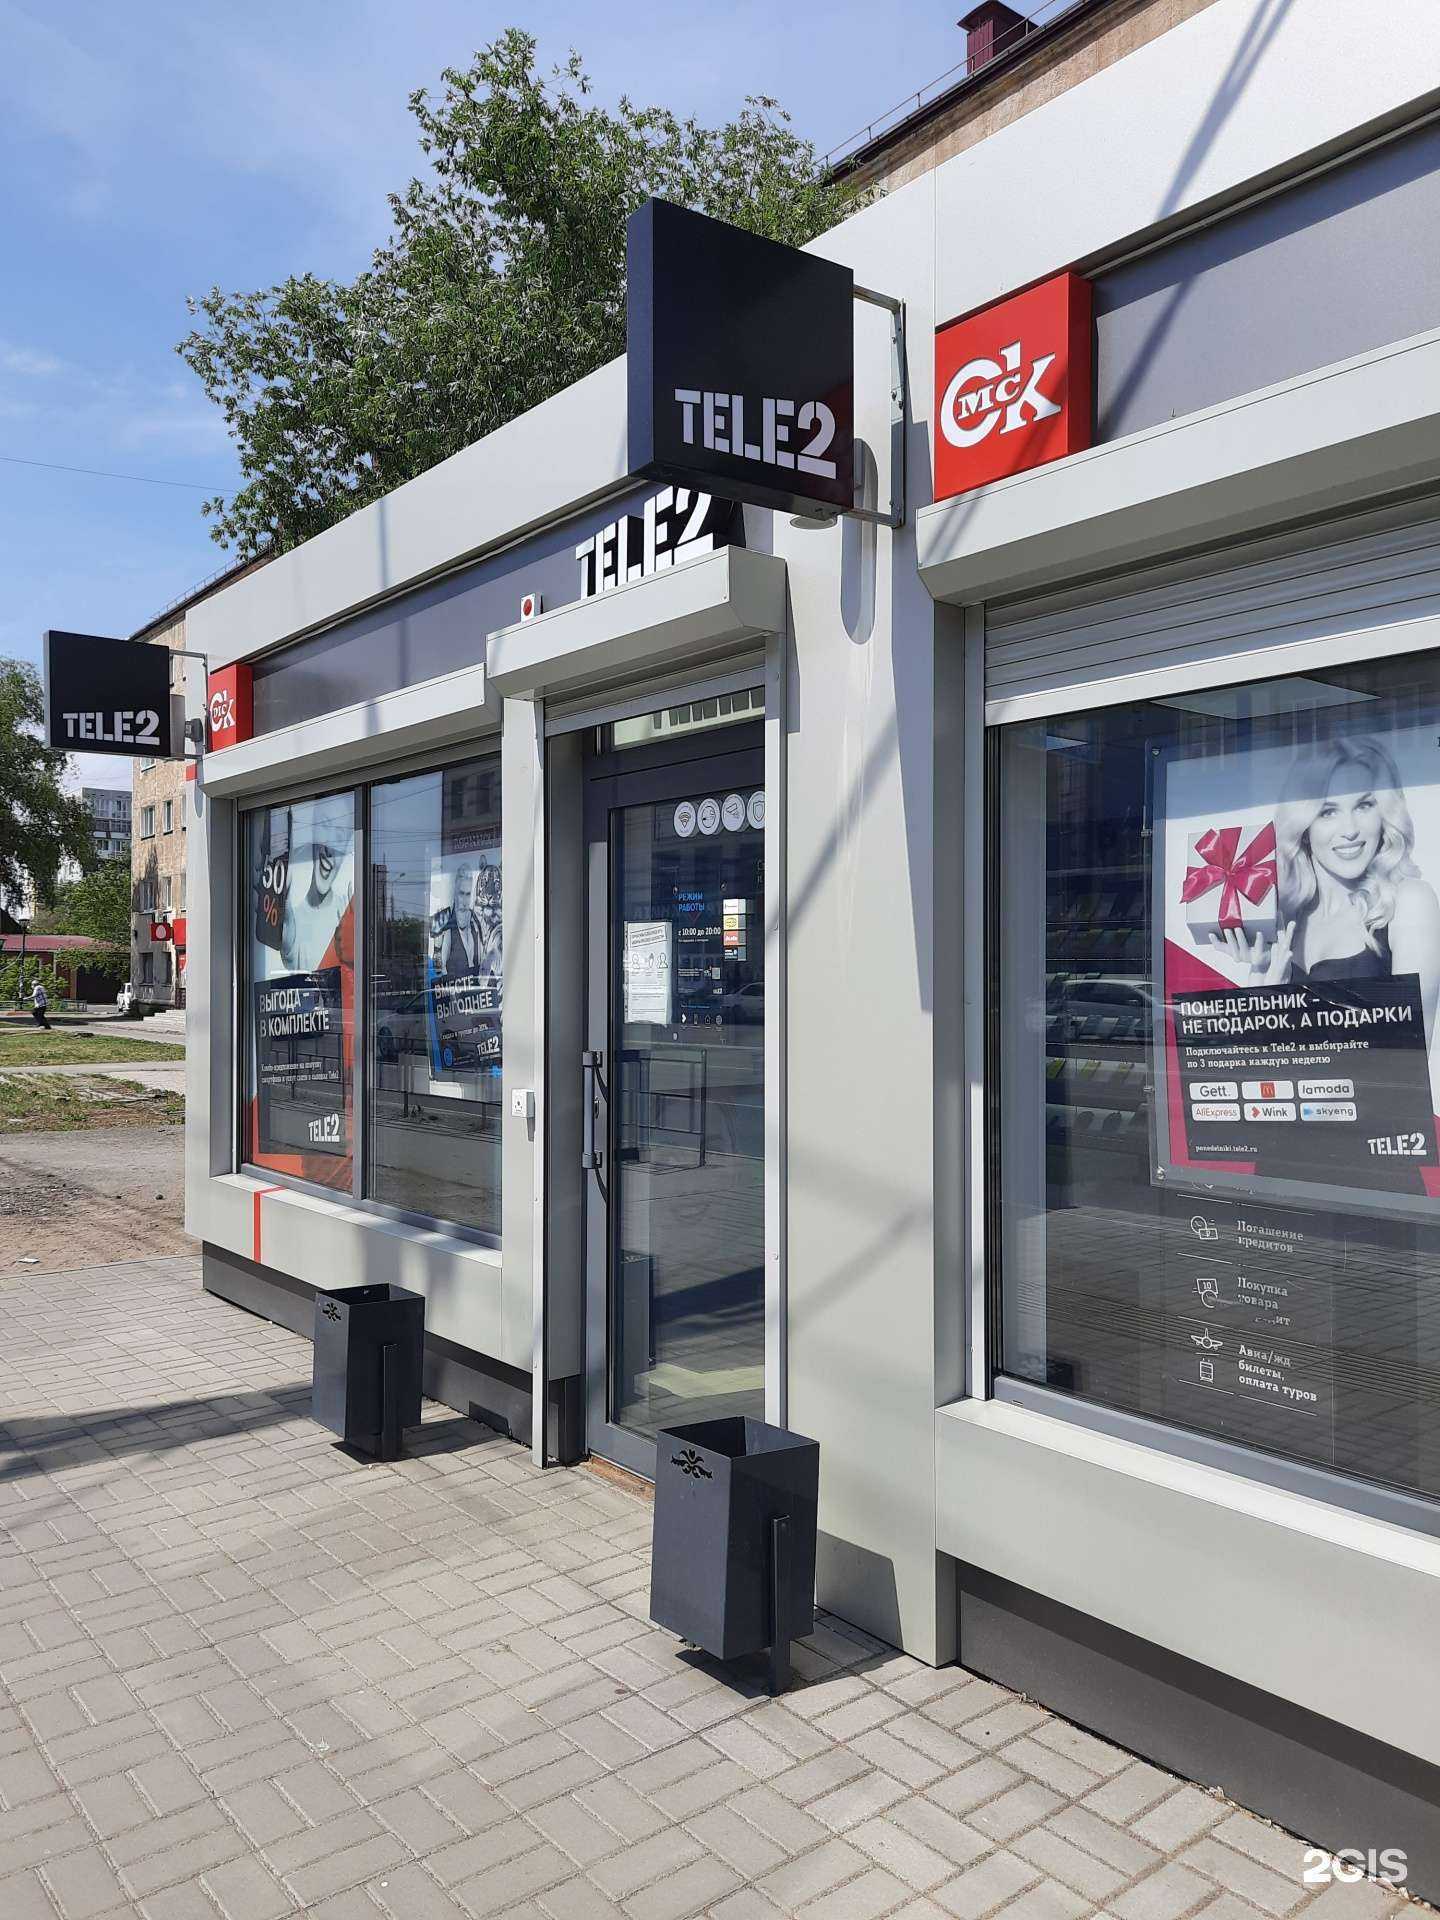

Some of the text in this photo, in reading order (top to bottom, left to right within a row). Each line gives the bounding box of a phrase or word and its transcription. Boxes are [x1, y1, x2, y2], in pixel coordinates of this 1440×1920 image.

[675, 389, 836, 480] TELE2
[576, 485, 713, 600] TELE2
[63, 710, 160, 745] TELE2
[263, 895, 278, 926] %
[679, 903, 705, 912] РАБОТЫ
[682, 928, 697, 936] 10:00
[705, 926, 721, 935] 20:00
[260, 988, 301, 1013] ВЫГОДА
[436, 991, 493, 1019] ВЫГОДНЕЕ
[1180, 993, 1307, 1016] ПОНЕДЕЛЬНИК
[268, 1010, 330, 1037] КОМПЛЕКТЕ
[1182, 1005, 1412, 1034] НЕ ПОДАРОК, А ПОДАРКИ
[477, 1036, 500, 1056] TELE2
[1185, 1045, 1260, 1057] Подключайтесь
[1270, 1042, 1296, 1052] Tele2
[1309, 1040, 1369, 1052] выбирайте
[1187, 1056, 1331, 1069] по 3 подарка каждую неделю
[1302, 1084, 1350, 1095] lamoda
[1196, 1107, 1238, 1119] AliExpress
[1262, 1107, 1288, 1117] Wink
[1315, 1107, 1354, 1117] skyeng
[308, 1114, 340, 1142] TELE2
[1367, 1132, 1427, 1155] TELE2
[1239, 1344, 1291, 1367] Авиа/жд
[1238, 1360, 1285, 1381] билеты,
[1239, 1376, 1317, 1401] оплата туров
